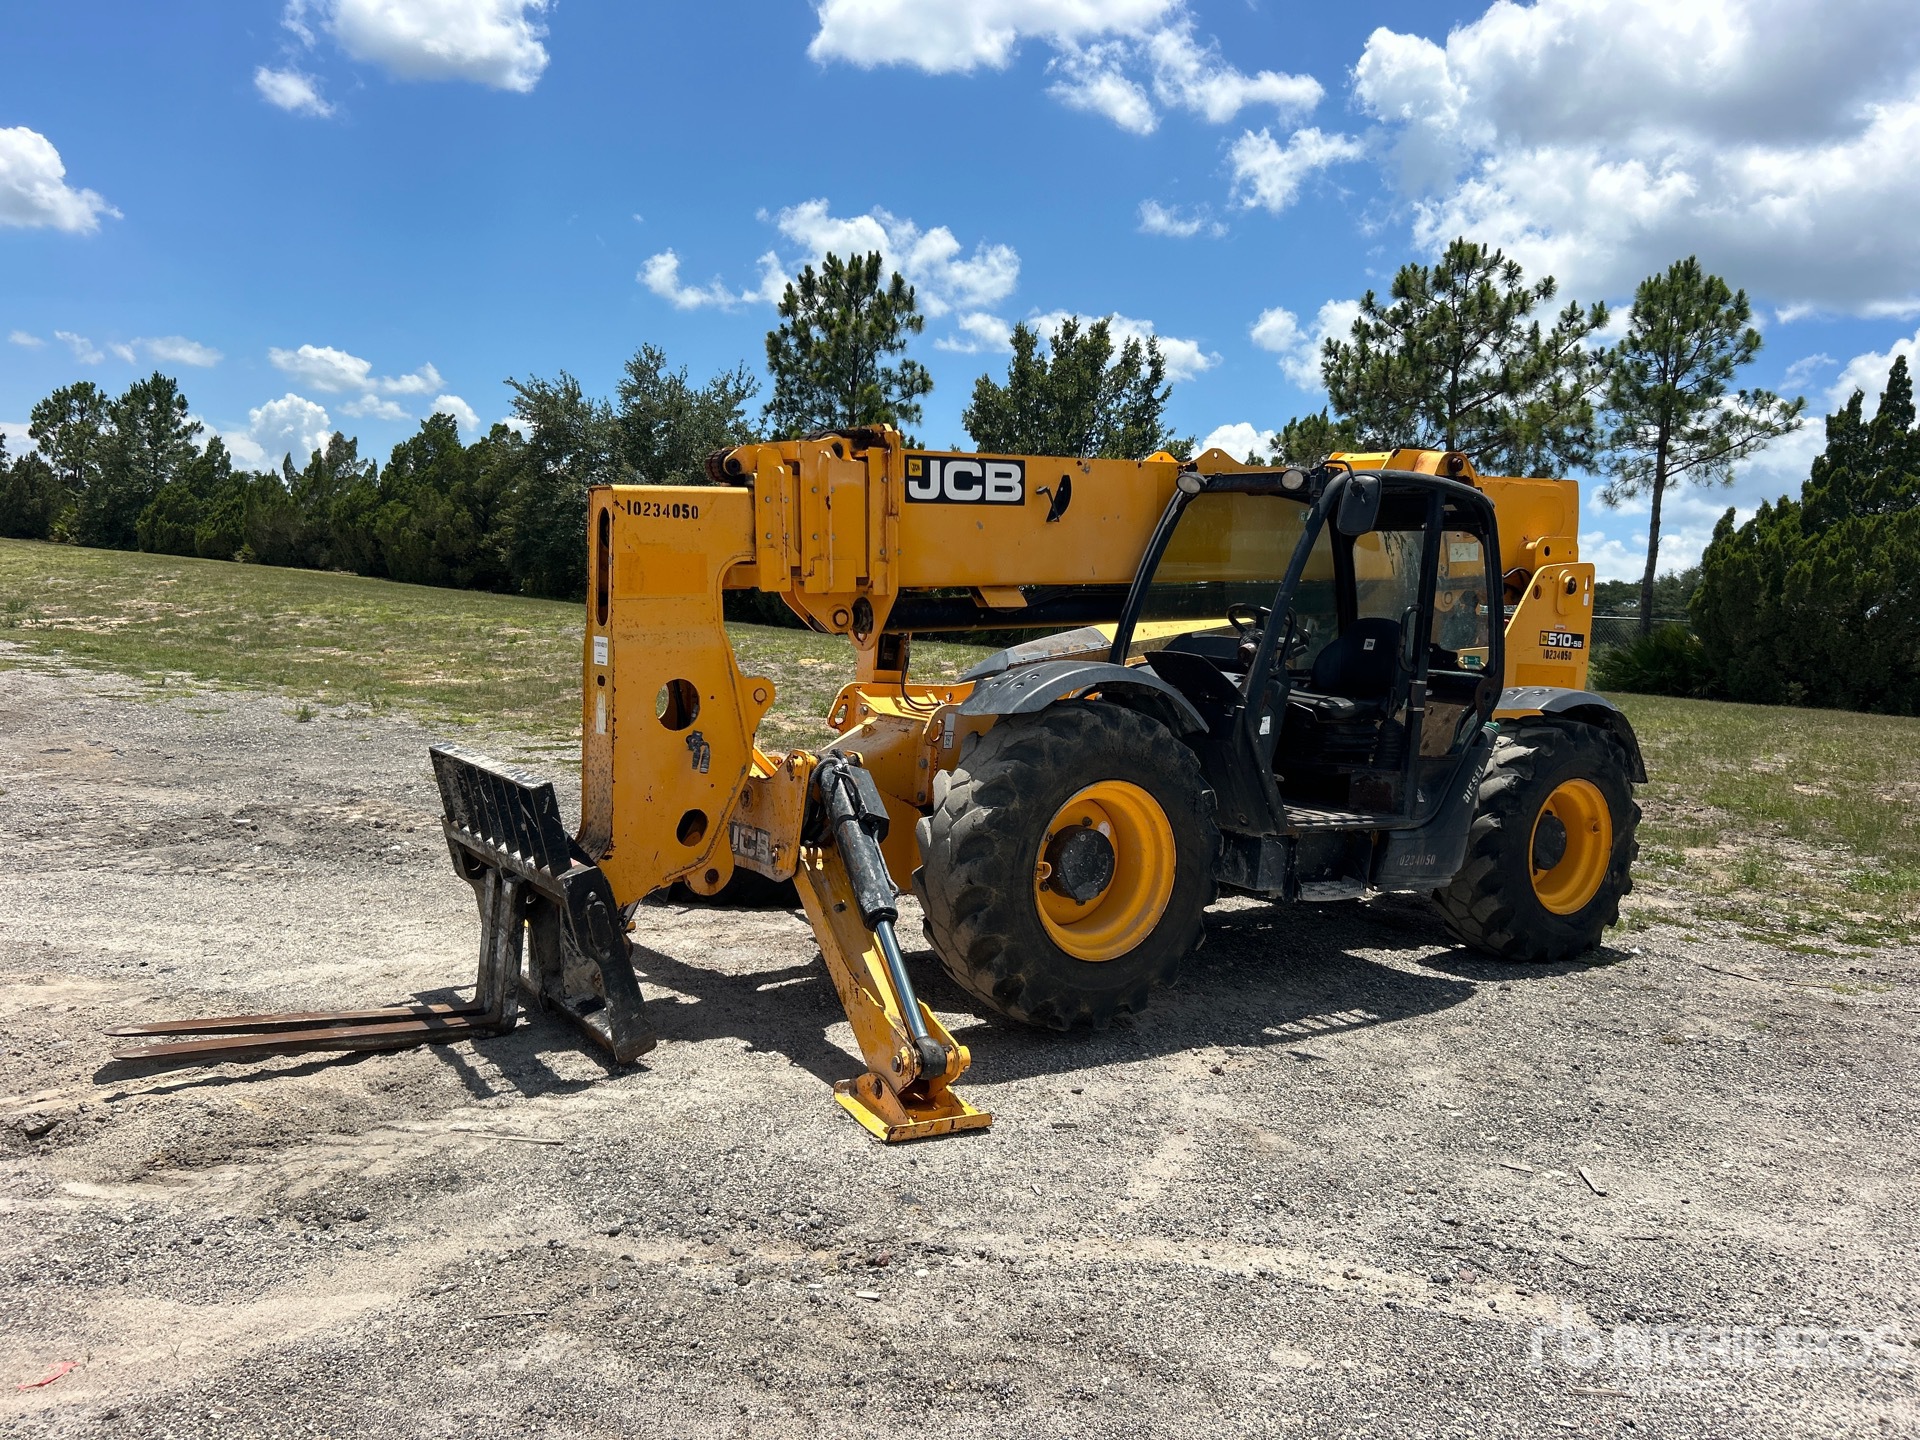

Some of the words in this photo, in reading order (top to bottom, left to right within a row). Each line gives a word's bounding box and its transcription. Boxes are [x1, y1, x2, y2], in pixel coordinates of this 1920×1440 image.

[908, 460, 1023, 502] JCB
[627, 499, 699, 520] 10234050
[1543, 649, 1573, 661] 10234050
[1463, 764, 1484, 804] DIESEL
[731, 825, 770, 863] JCB
